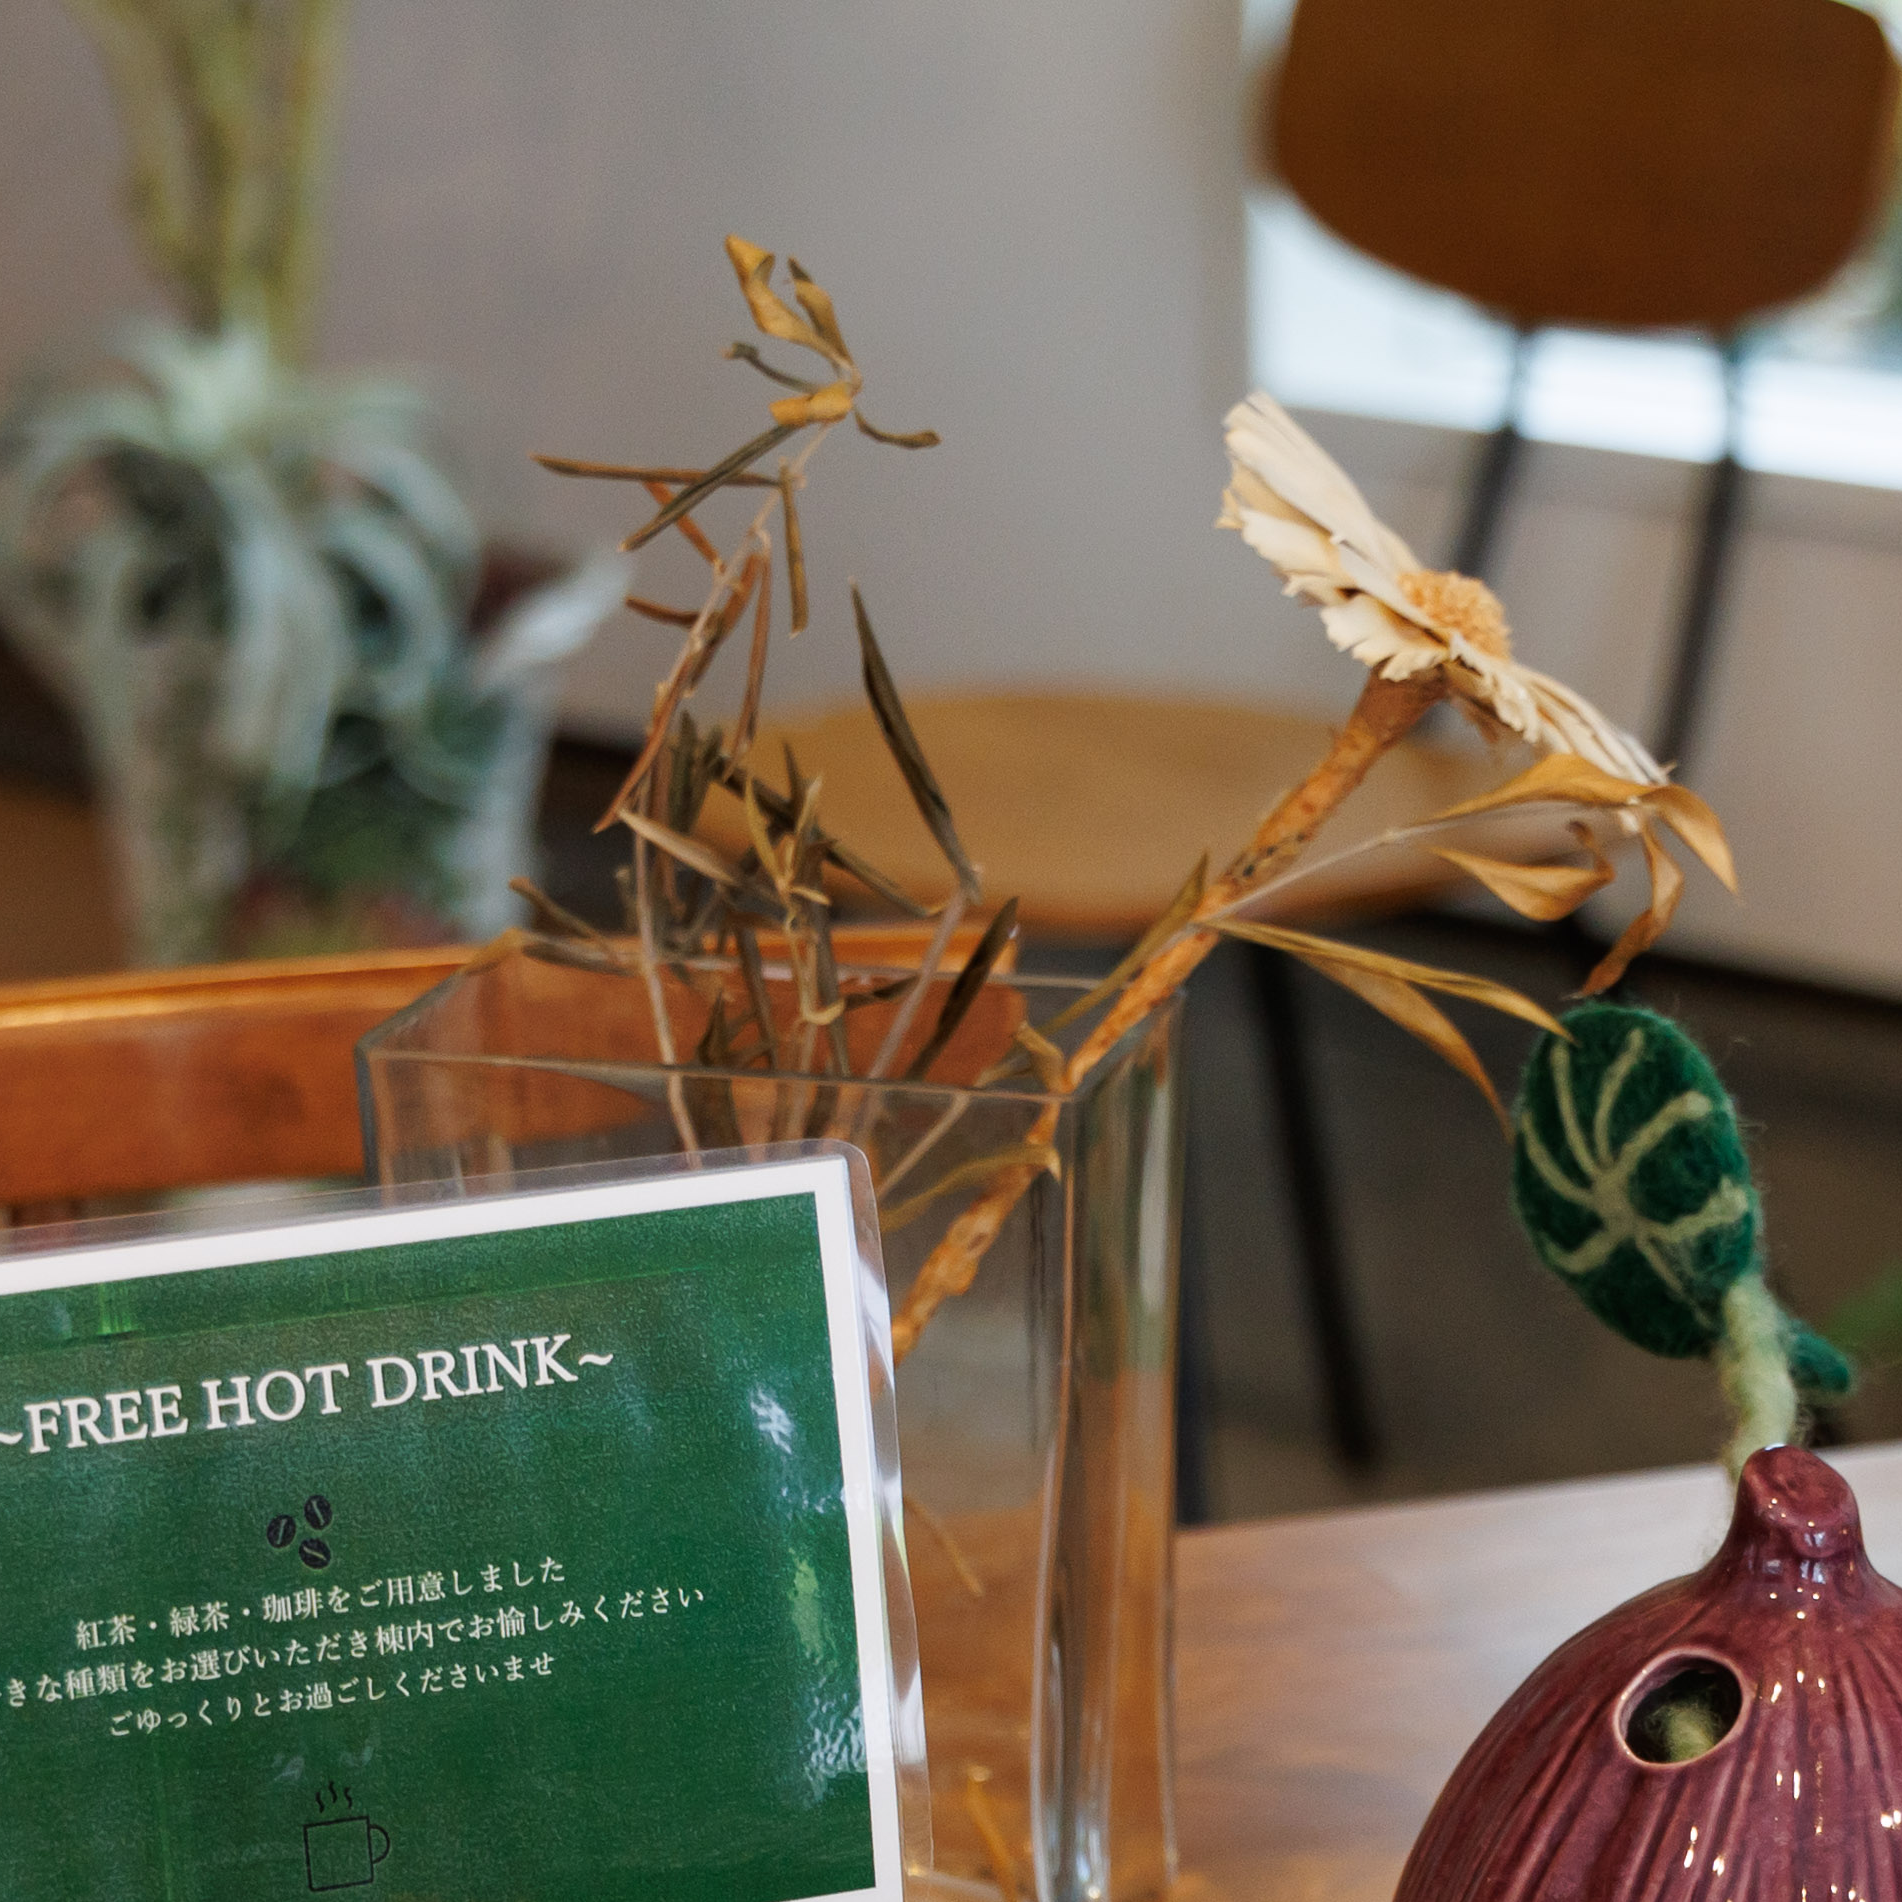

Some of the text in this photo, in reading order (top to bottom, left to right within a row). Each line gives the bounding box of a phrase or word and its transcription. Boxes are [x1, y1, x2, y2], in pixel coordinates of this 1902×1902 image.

[201, 1363, 351, 1430] HOT
[74, 1556, 566, 1651] 紅茶・緑茶・珈琲をご用意しました
[109, 1651, 556, 1737] ごゆっくりとお過ごしくださいませ
